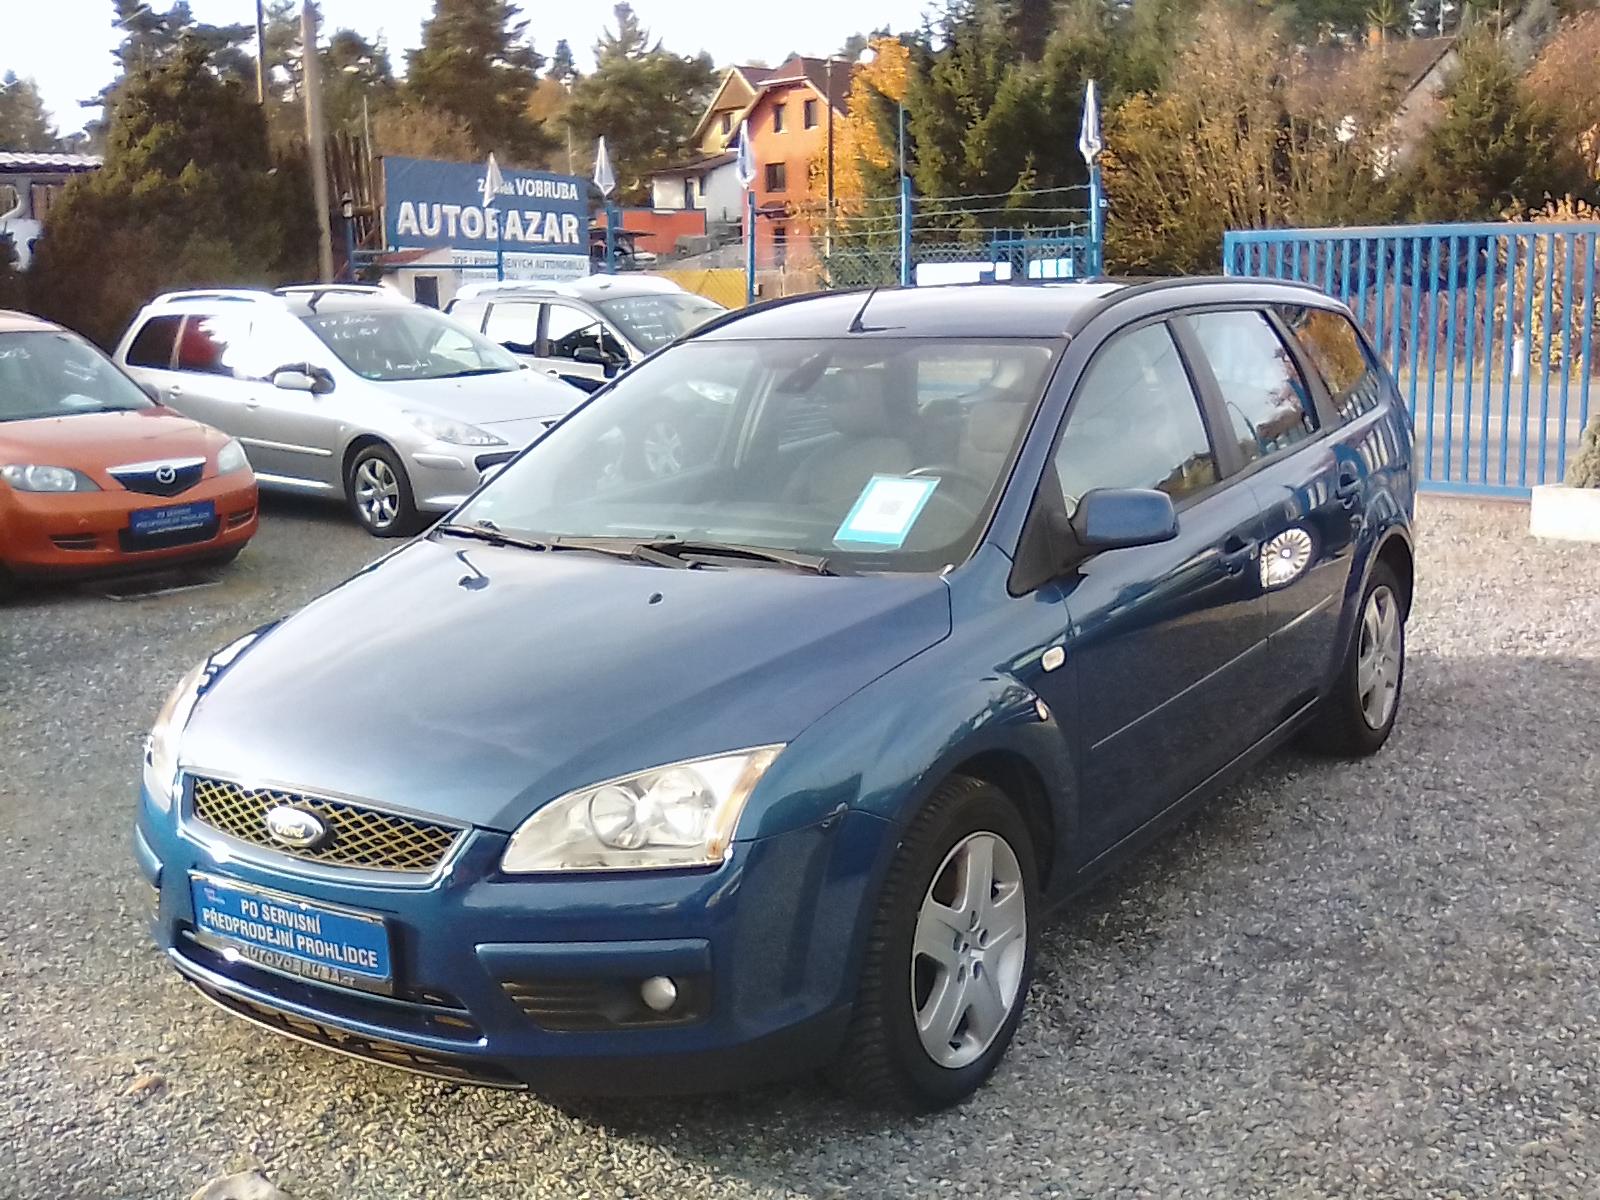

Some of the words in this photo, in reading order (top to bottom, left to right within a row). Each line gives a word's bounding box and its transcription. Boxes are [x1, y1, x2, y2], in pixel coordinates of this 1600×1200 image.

[515, 178, 579, 200] VOBRUBA
[397, 201, 580, 244] AUTOBAZAR
[240, 898, 259, 919] PO
[261, 903, 321, 935] SERVISNÍ
[202, 907, 295, 949] PŘEDPRODEJNÍ
[296, 933, 379, 968] PROHLÍDCE
